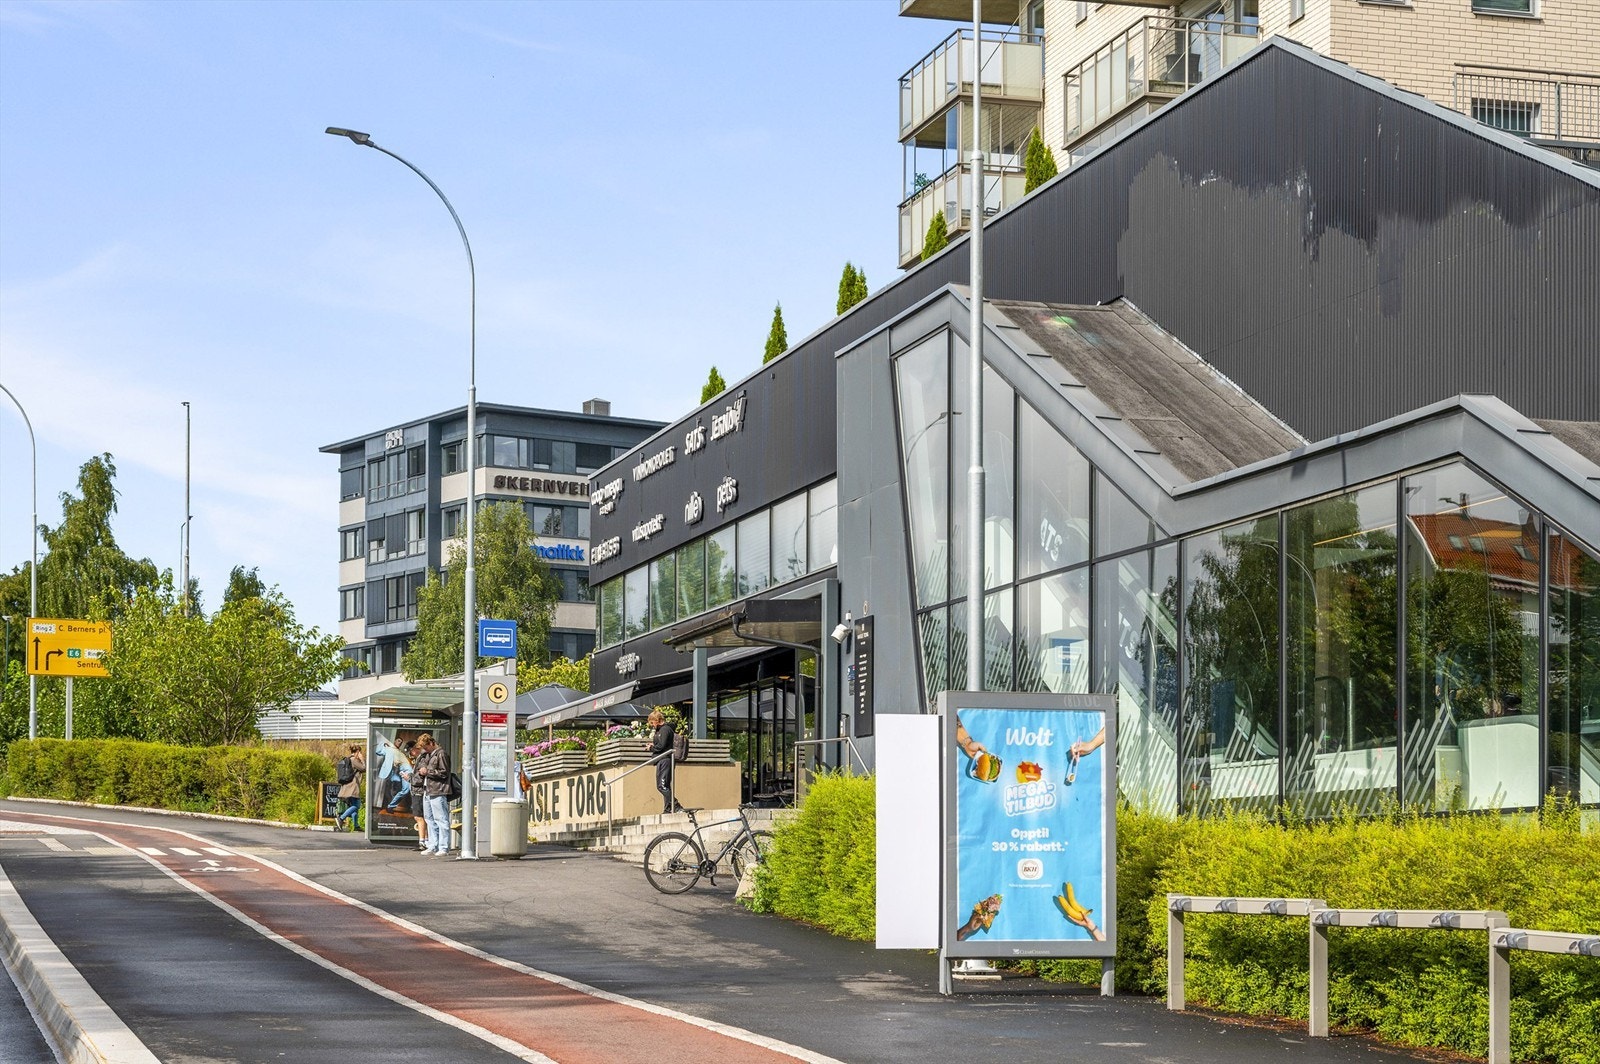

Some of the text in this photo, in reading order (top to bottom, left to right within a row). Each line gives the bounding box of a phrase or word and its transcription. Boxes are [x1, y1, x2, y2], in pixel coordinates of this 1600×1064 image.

[68, 625, 96, 633] Berners
[493, 687, 503, 699] C
[1006, 727, 1054, 746] Wolt
[567, 771, 607, 818] TORG
[1006, 782, 1053, 801] MEGA-
[1006, 795, 1055, 814] TILBUD
[1011, 828, 1049, 840] Opptil
[992, 842, 1007, 852] 30
